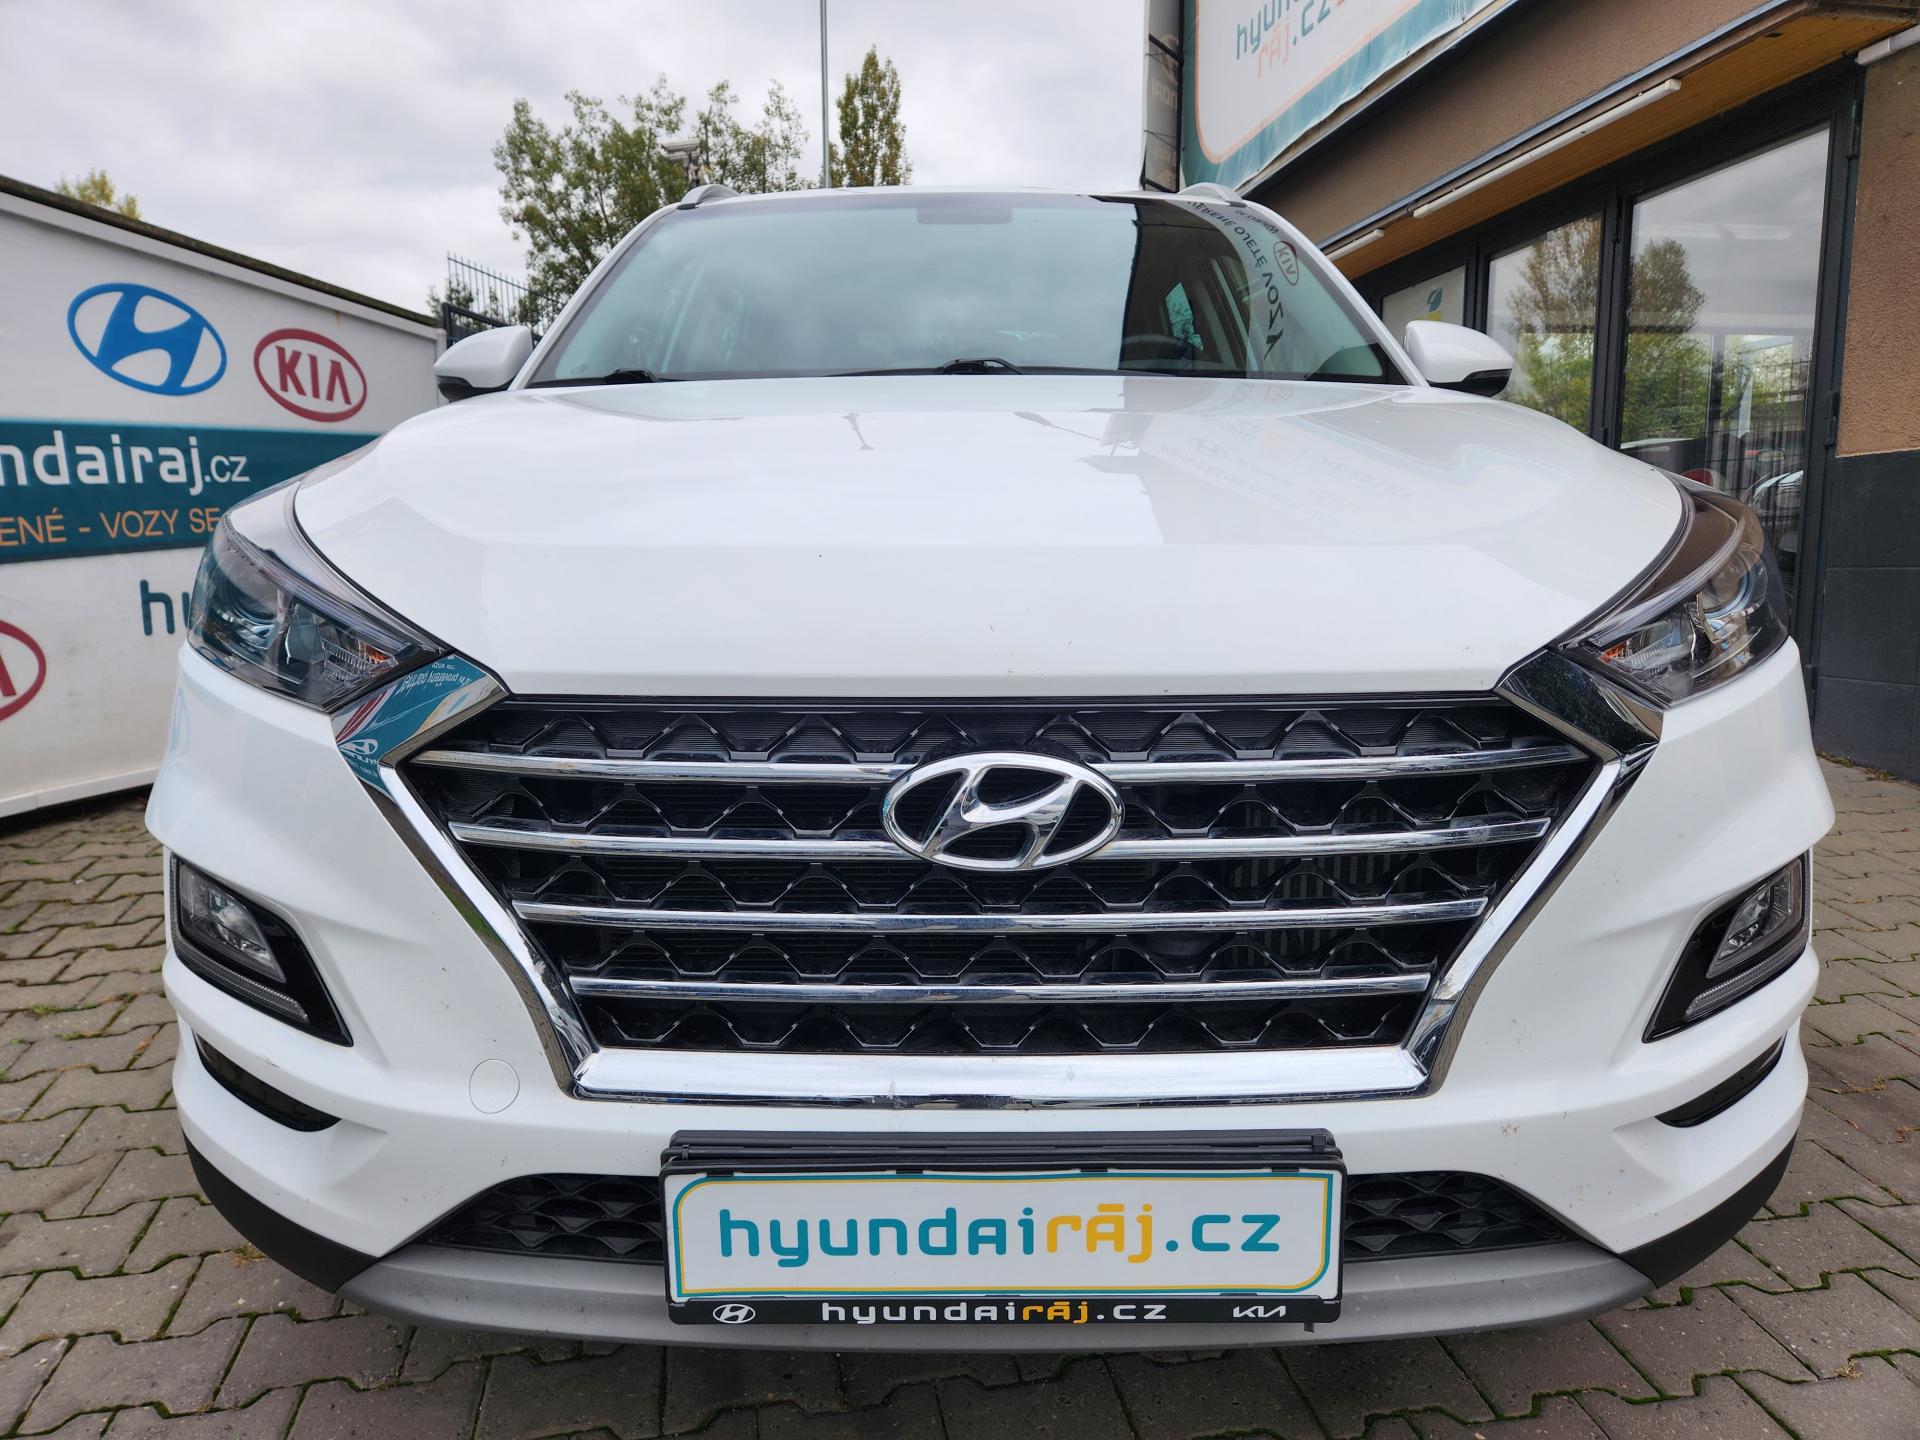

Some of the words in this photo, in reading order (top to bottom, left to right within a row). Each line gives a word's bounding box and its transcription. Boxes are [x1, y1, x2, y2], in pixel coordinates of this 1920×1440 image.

[275, 345, 352, 405] KIA
[100, 509, 179, 538] VOZY
[189, 508, 222, 532] SE
